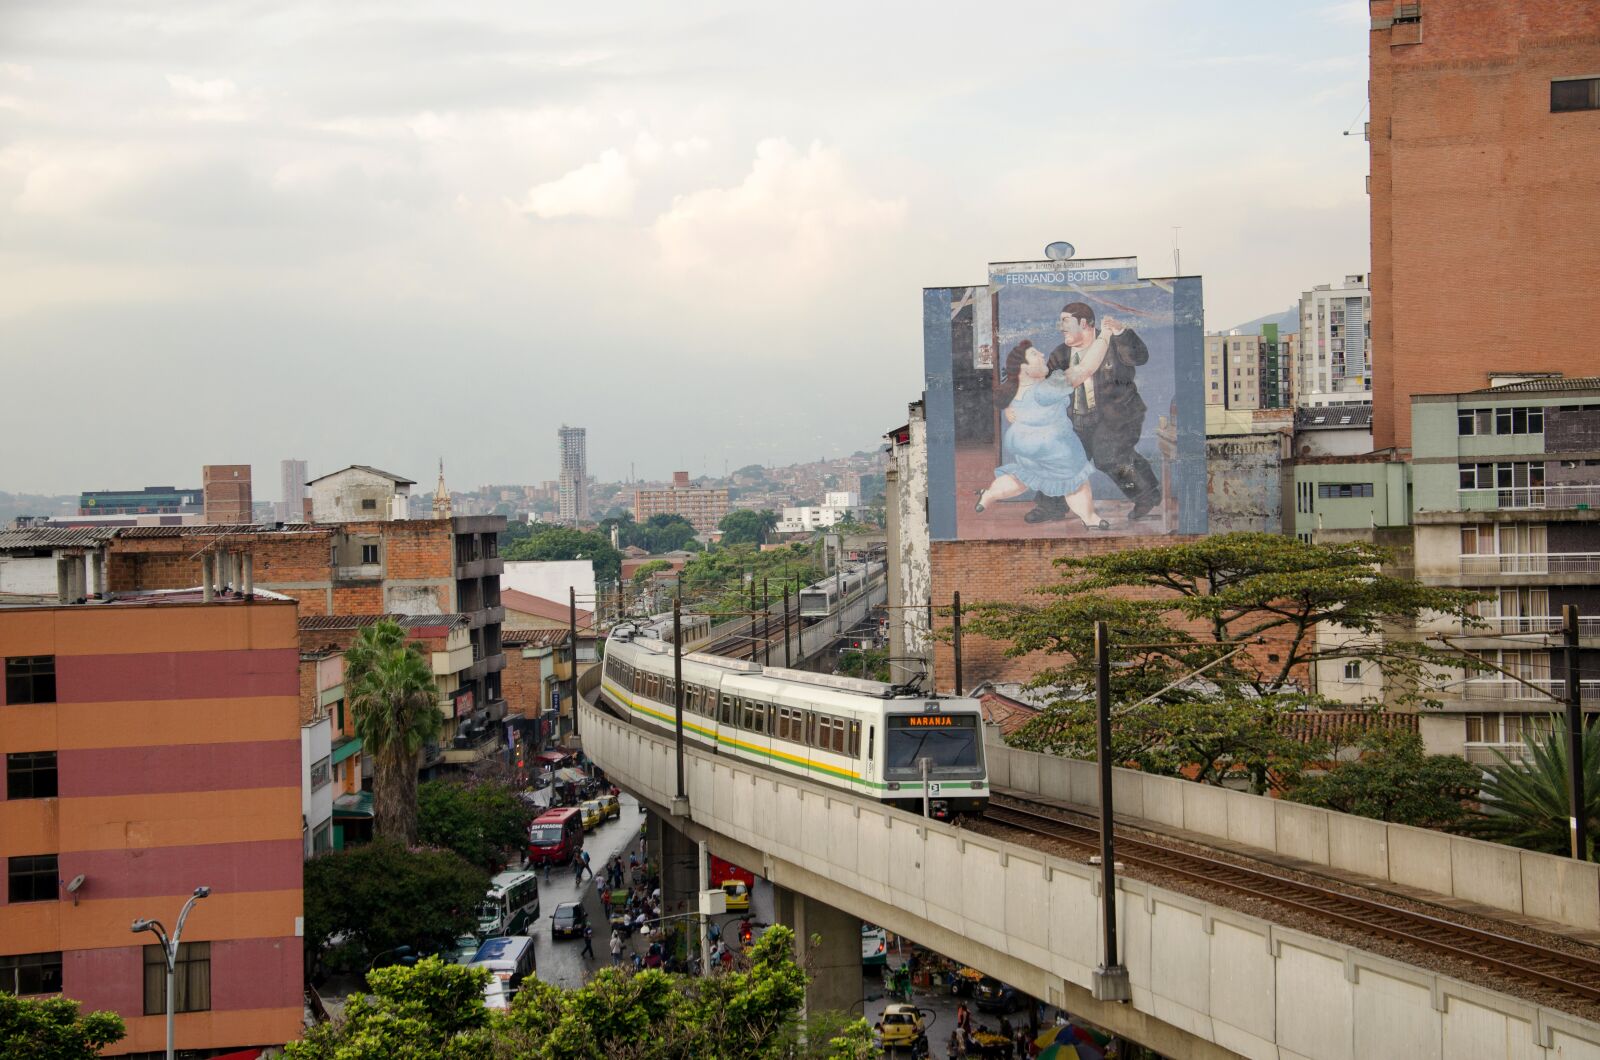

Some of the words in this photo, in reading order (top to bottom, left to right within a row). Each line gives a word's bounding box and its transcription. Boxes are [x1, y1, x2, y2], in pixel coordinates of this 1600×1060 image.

[1006, 272, 1065, 285] FERNANDO
[1067, 270, 1110, 283] BOTERO
[910, 717, 952, 726] NARANJA
